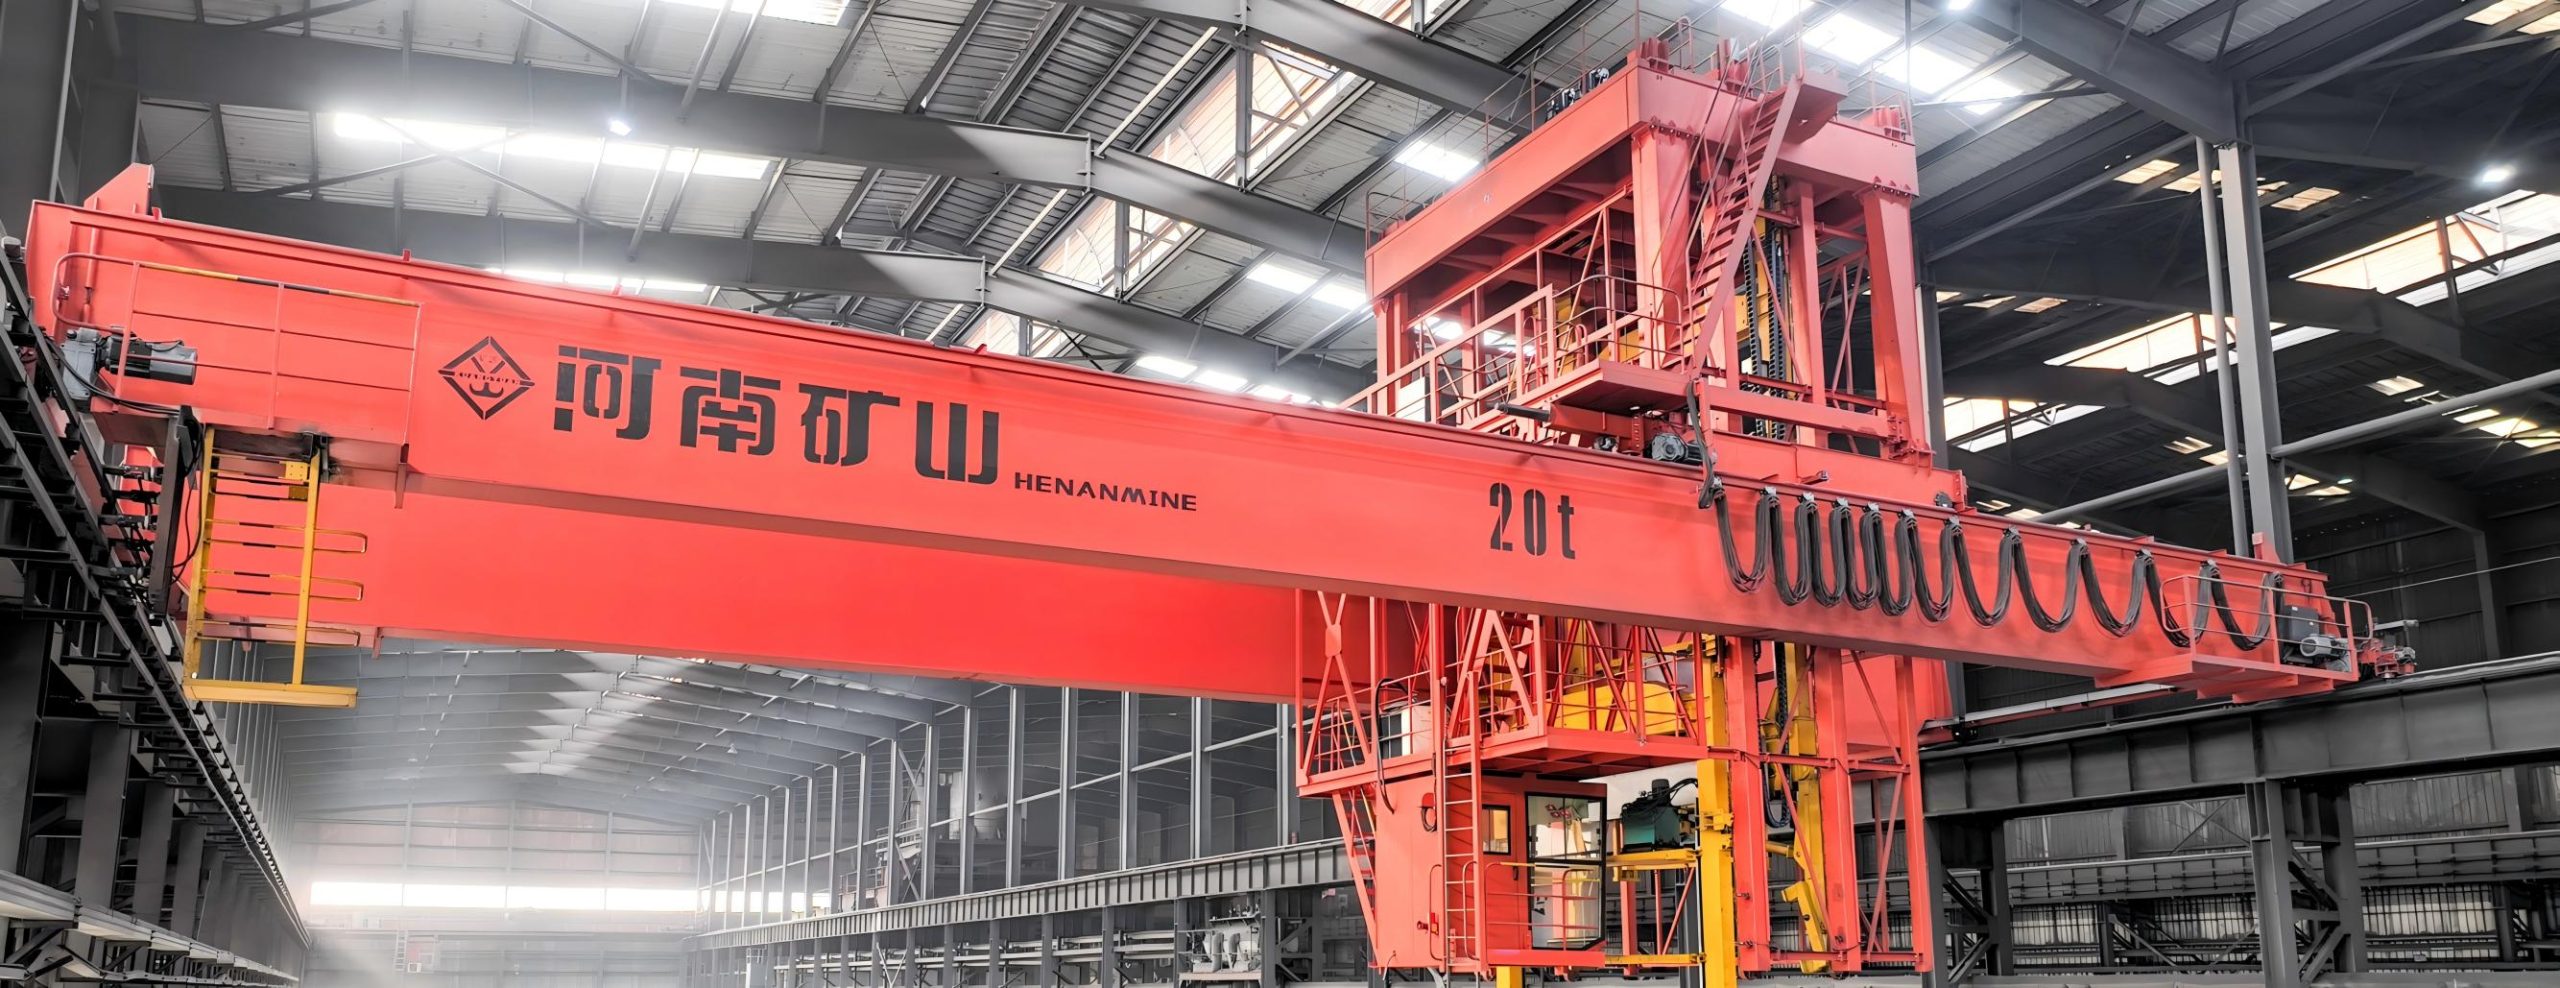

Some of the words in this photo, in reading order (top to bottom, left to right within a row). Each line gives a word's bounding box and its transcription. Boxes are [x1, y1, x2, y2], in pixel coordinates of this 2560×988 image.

[553, 344, 999, 486] 河南矿山
[1014, 471, 1197, 512] HENANMINE
[1489, 482, 1576, 560] 20t
